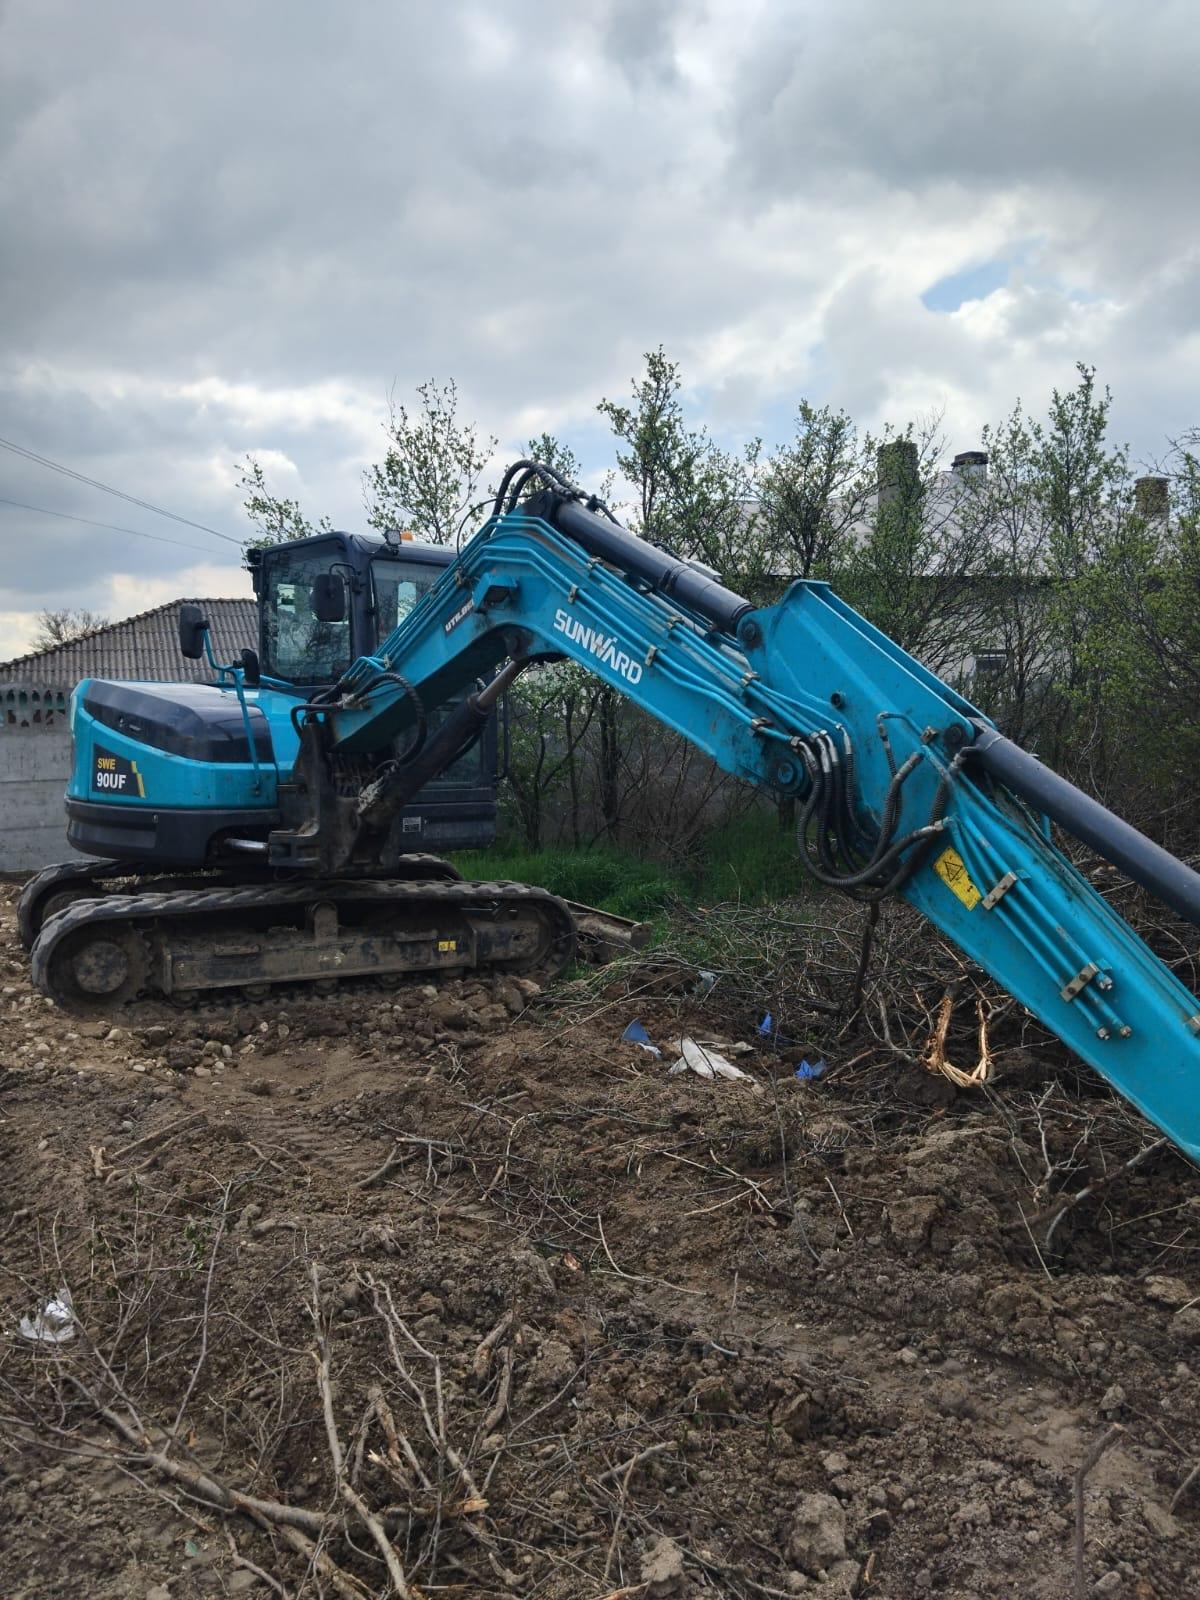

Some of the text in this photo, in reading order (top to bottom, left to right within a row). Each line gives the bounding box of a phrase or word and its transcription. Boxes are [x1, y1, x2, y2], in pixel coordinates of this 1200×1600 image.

[553, 608, 643, 684] SUNWARD
[97, 757, 116, 770] SWE
[96, 772, 127, 789] 90UF
